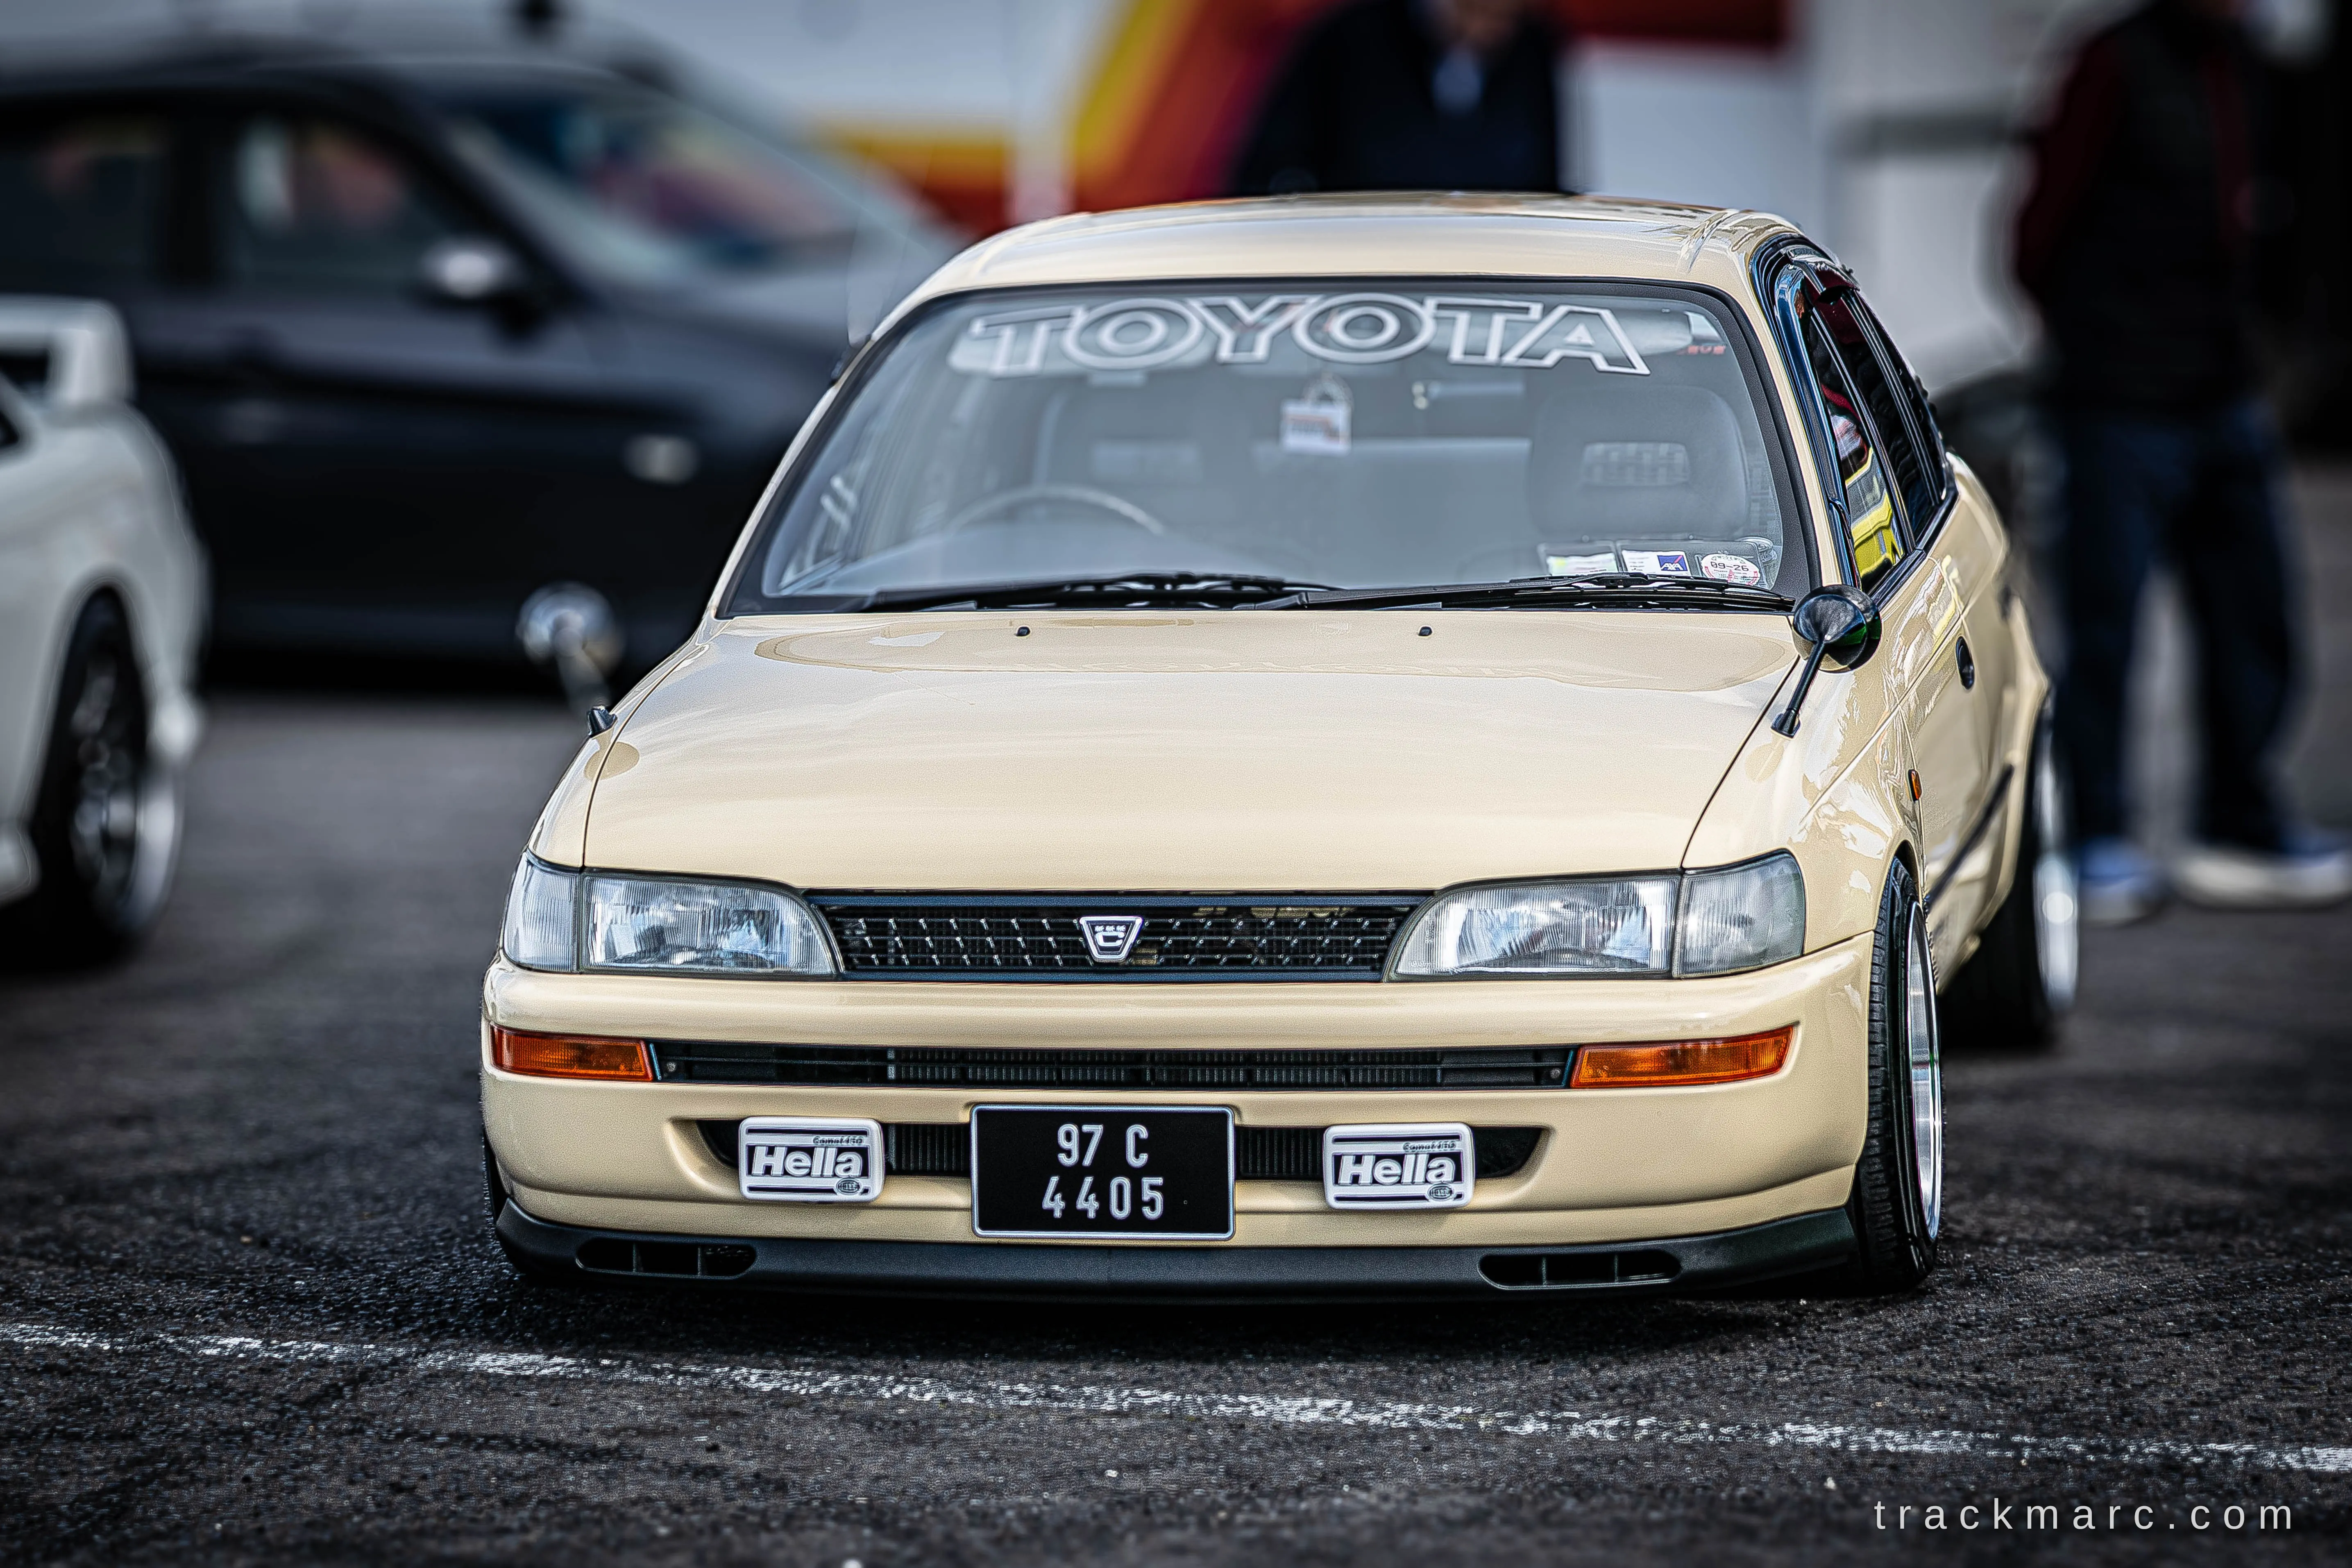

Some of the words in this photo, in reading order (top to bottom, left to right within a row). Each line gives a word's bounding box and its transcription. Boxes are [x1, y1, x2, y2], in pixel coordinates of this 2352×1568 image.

[971, 293, 1651, 376] TOYOTA
[1710, 561, 1749, 572] 09-26
[751, 1146, 863, 1178] Hella
[1057, 1124, 1103, 1167] 97
[1126, 1124, 1148, 1168] C
[1338, 1153, 1456, 1186] Hella
[1042, 1176, 1163, 1220] 4405
